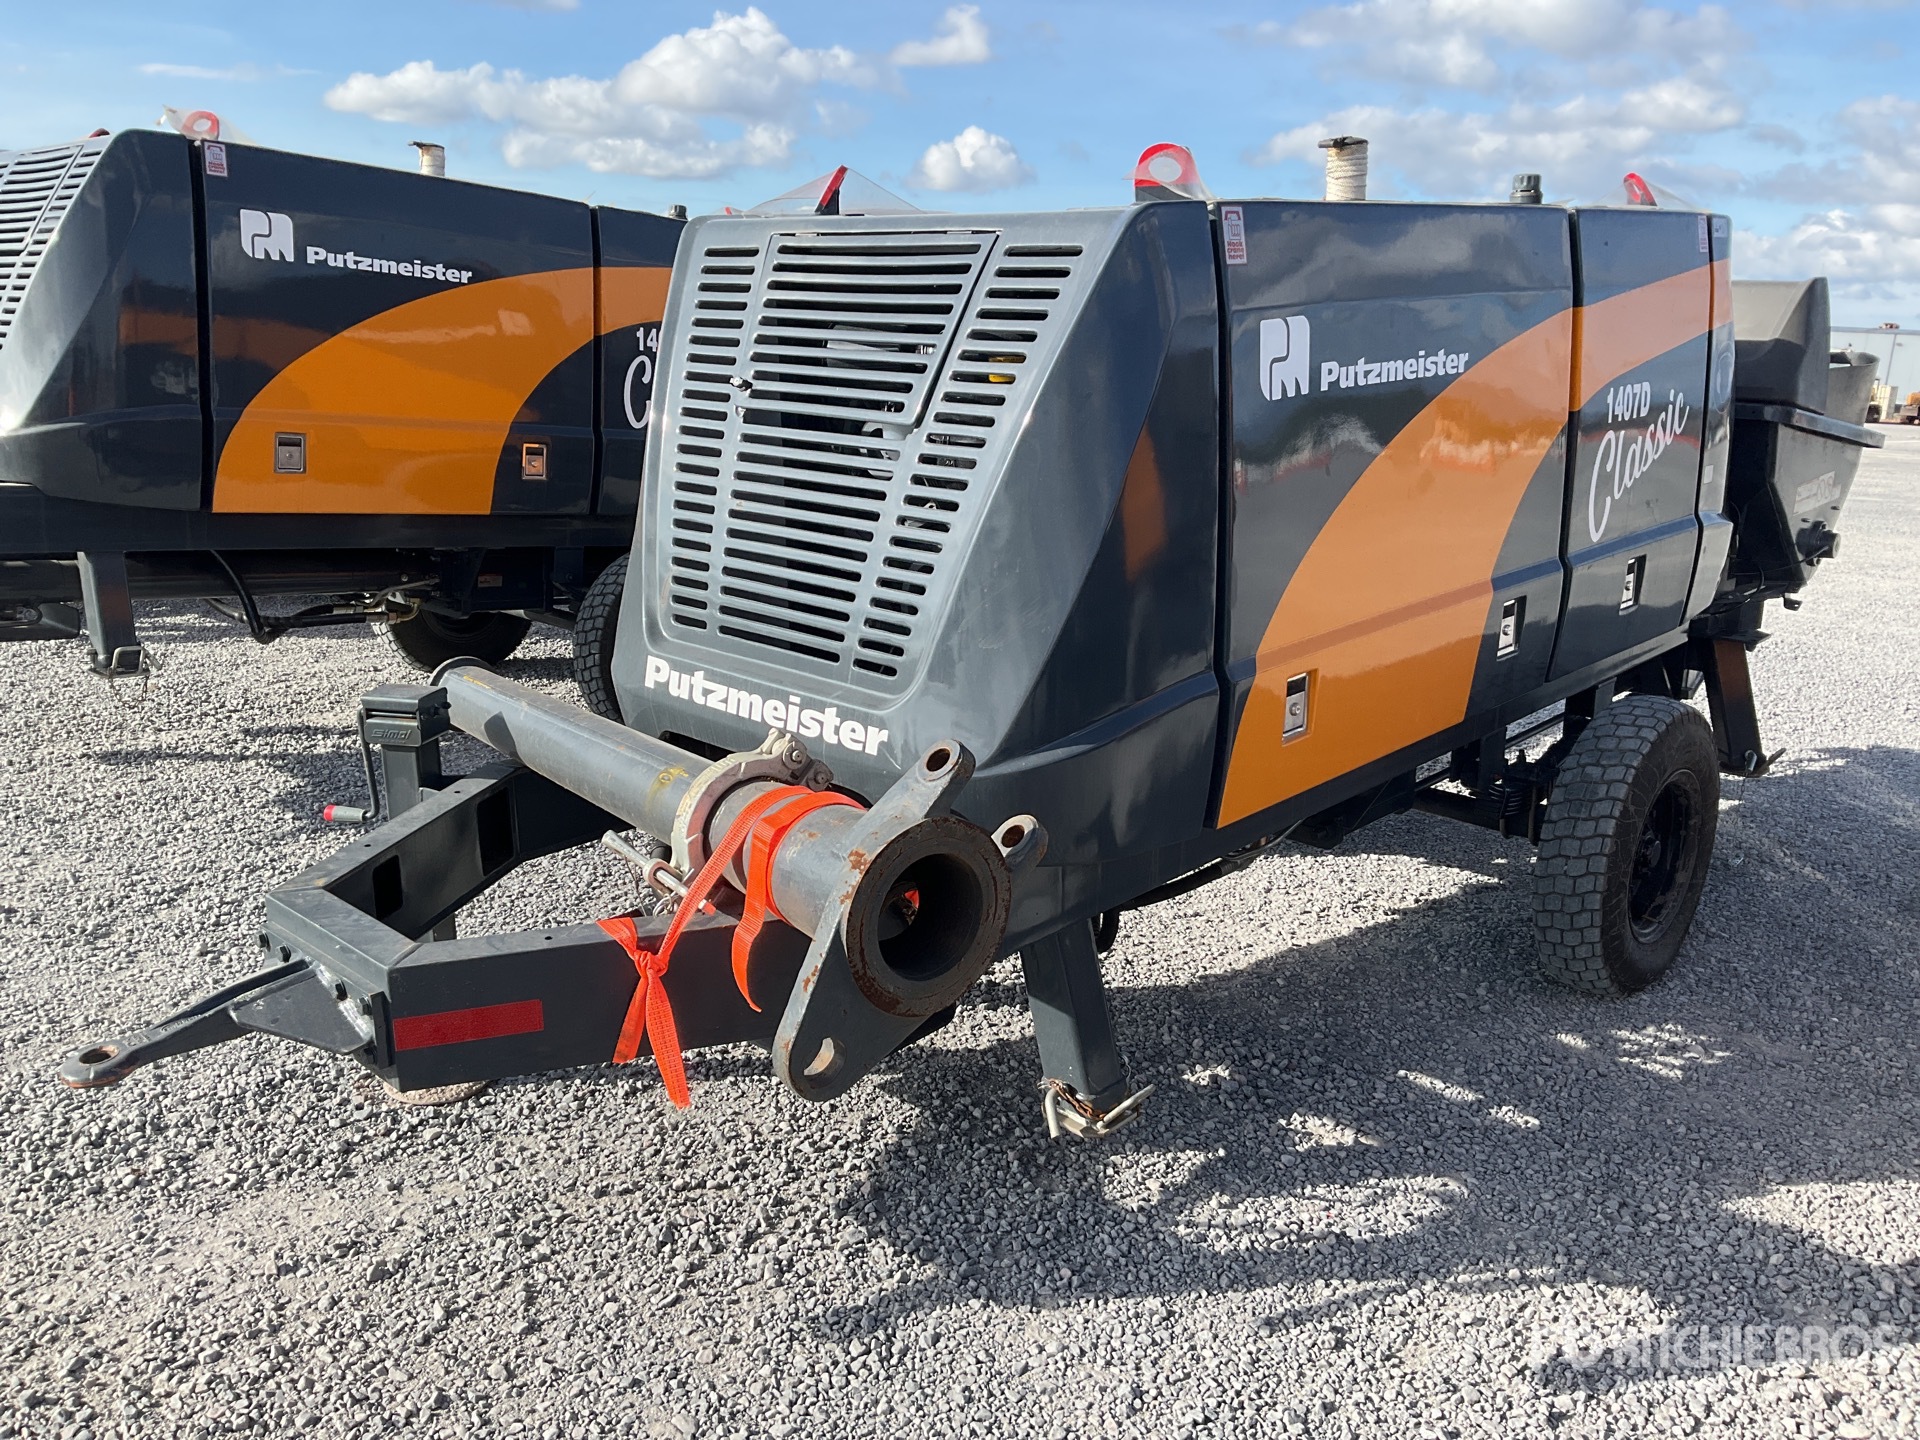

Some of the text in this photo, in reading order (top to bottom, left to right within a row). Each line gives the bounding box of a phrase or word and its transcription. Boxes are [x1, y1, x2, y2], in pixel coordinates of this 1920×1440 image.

[306, 245, 473, 284] Putzmeister
[1320, 348, 1469, 392] Putzmeister
[1606, 381, 1651, 424] 1407D
[1588, 388, 1690, 543] Classic
[644, 655, 889, 757] Putzmeister
